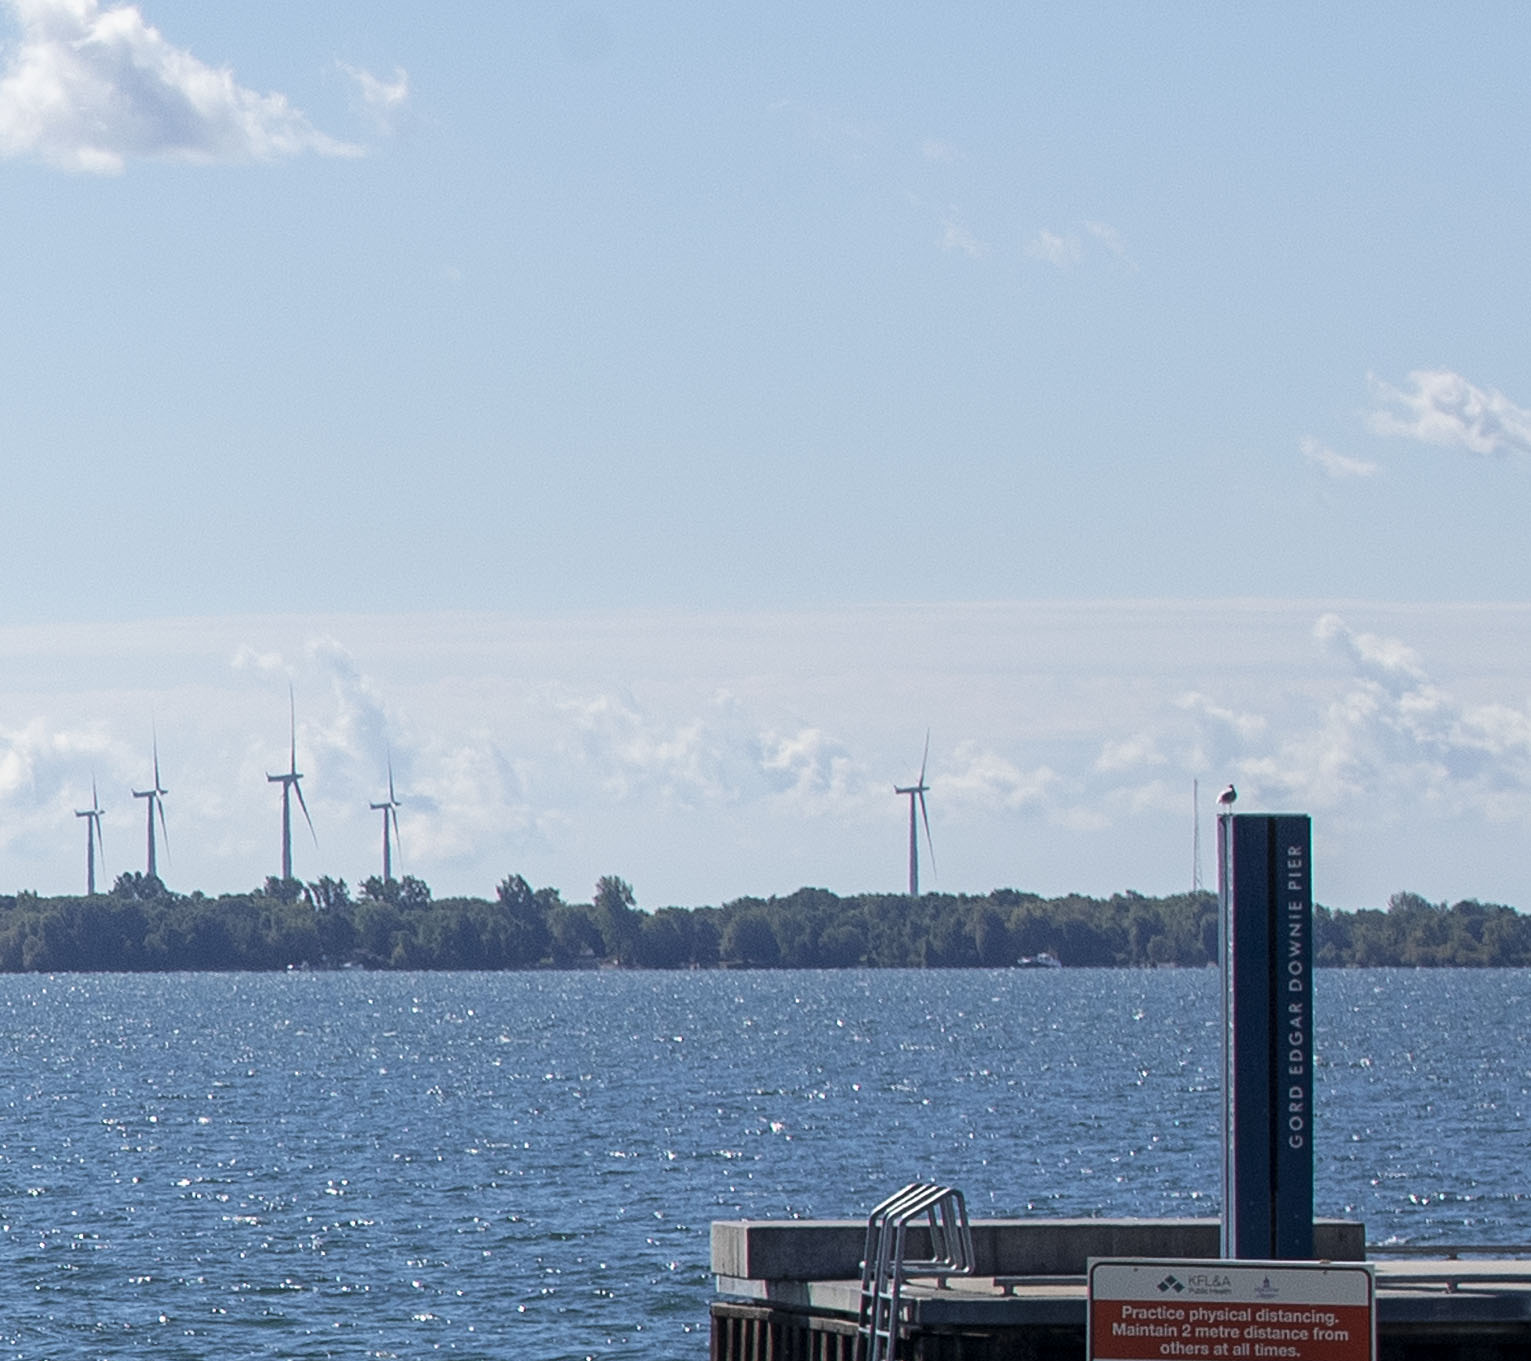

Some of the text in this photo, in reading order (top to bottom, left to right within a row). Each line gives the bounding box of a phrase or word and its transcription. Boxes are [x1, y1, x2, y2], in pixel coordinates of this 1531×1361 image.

[1288, 846, 1304, 1149] GORD EDGAR DOWNIE PIER
[1188, 1275, 1232, 1288] KFL&A
[1121, 1305, 1340, 1326] Practice physical distancing.
[1111, 1322, 1349, 1342] Maintain 2 metre distance from
[1159, 1341, 1301, 1358] others at all times.
